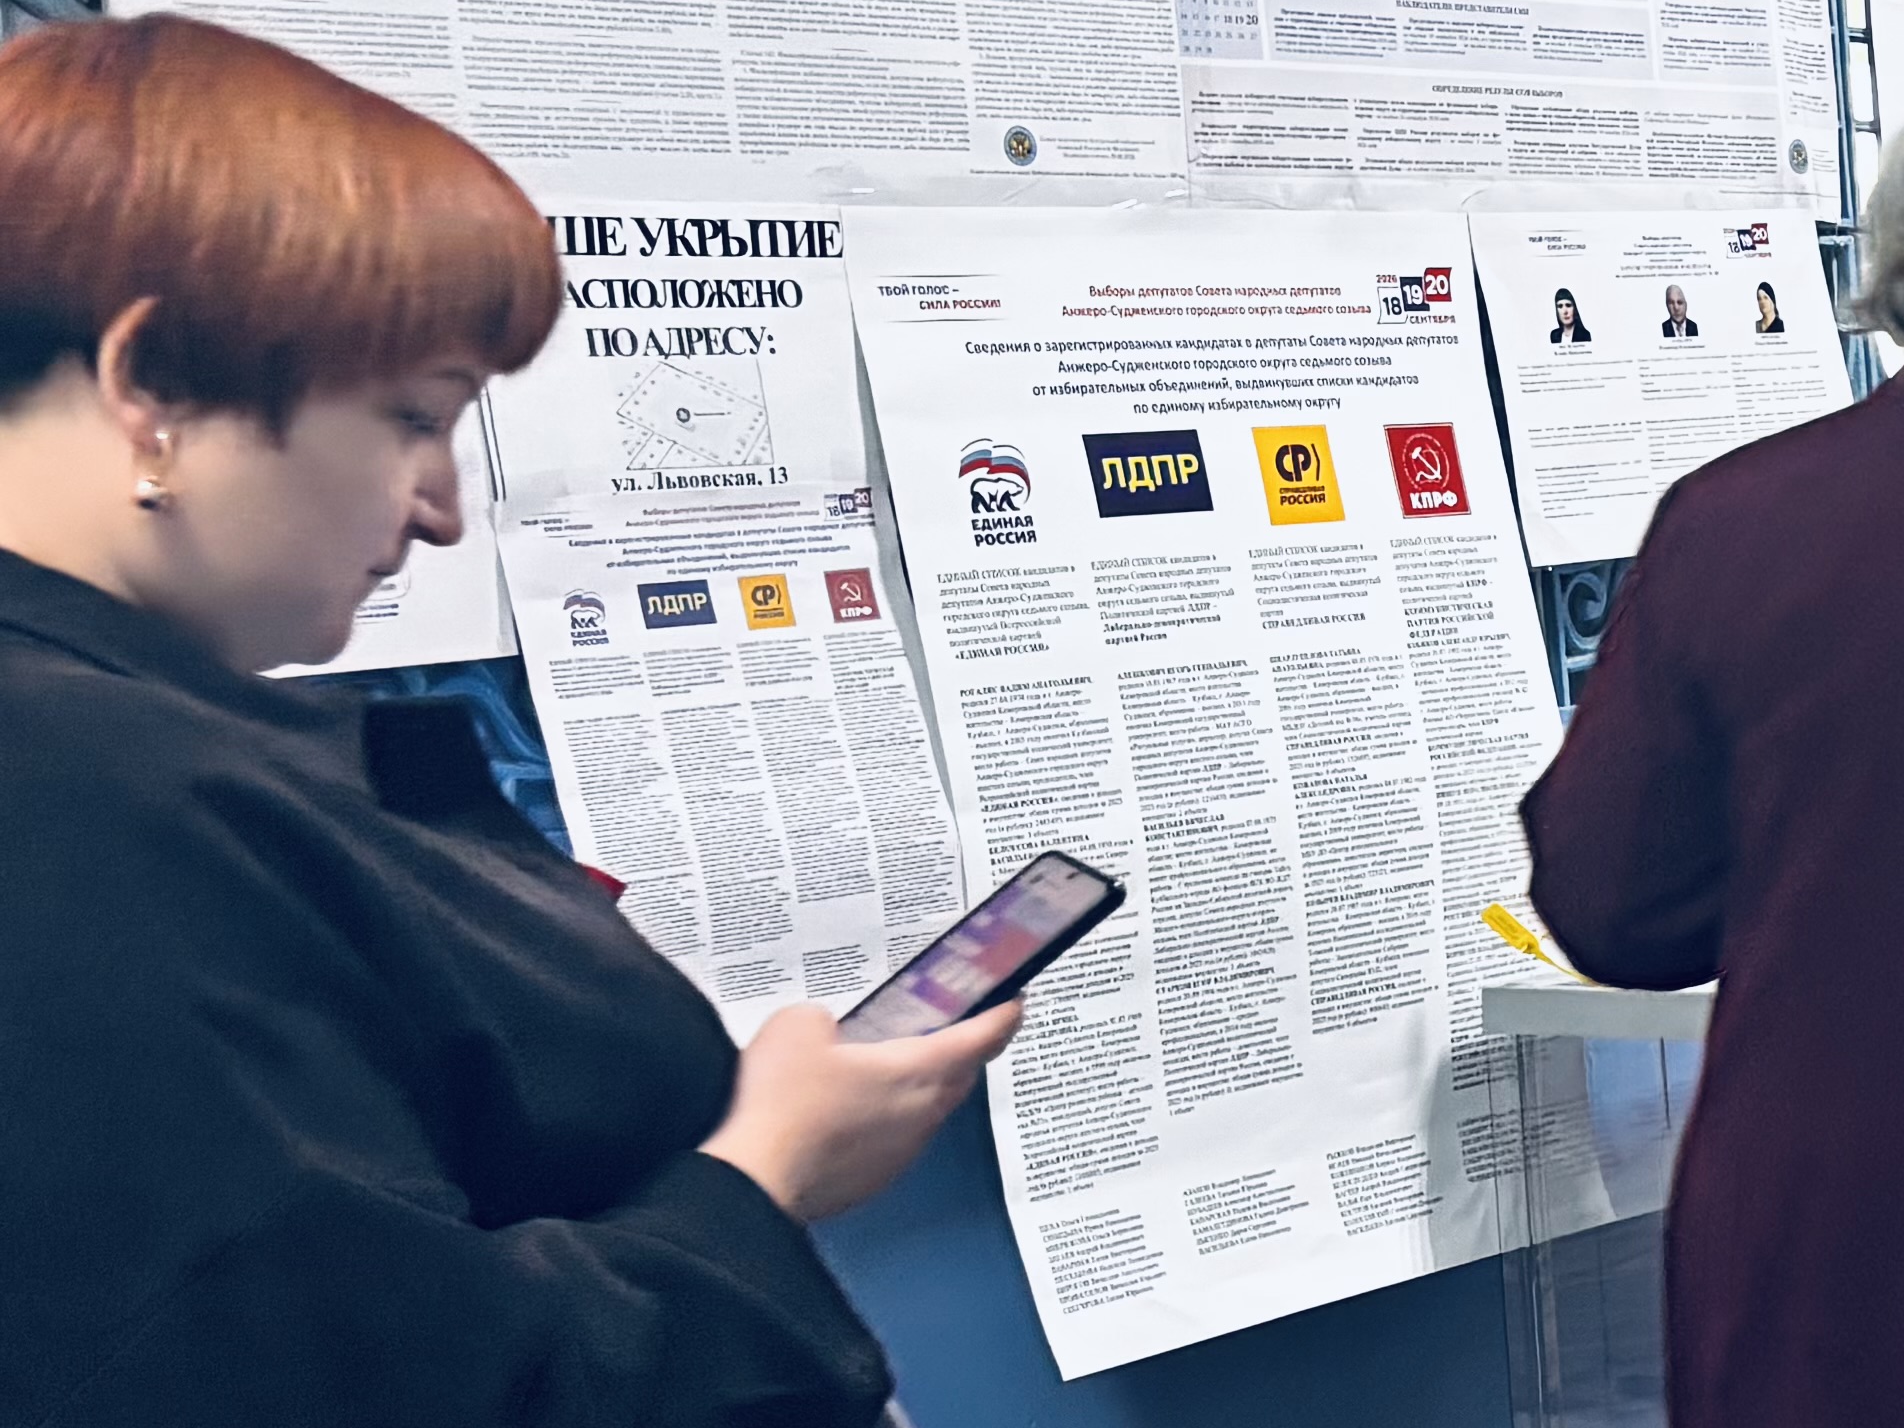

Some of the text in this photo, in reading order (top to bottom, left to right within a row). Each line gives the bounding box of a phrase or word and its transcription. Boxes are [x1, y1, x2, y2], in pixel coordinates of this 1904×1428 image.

[1245, 14, 1258, 25] 20
[545, 216, 843, 258] ШЕ УКРЫТИЕ
[1752, 227, 1768, 241] 20
[565, 278, 802, 309] АСПОЛОЖЕНО
[877, 284, 949, 296] ТВОЙ ГОЛОС
[1088, 284, 1135, 299] Выборы
[1137, 287, 1193, 298] депутатов
[1195, 285, 1232, 296] Совета
[1234, 287, 1287, 297] народных
[1382, 275, 1449, 315] 18 19 20
[919, 300, 950, 310] СИЛА
[1062, 304, 1183, 318] Анжеро-Судженского
[1185, 306, 1246, 317] городского
[1247, 305, 1283, 316] округа
[1284, 305, 1334, 315] седьмого
[586, 326, 776, 359] ПО АДРЕСУ:
[964, 341, 1031, 355] Сведения
[1044, 340, 1173, 354] зарегистрированных
[1175, 338, 1243, 351] кандидатах
[1255, 337, 1307, 350] депутаты
[1309, 335, 1346, 347] Совета
[1348, 336, 1403, 348] народных
[1405, 335, 1458, 347] депутатов
[1058, 356, 1392, 374] Анжеро-Судженского городского округа седьмого созыва
[1032, 385, 1046, 396] от
[1049, 382, 1146, 397] избирательных
[1148, 377, 1232, 393] объединений,
[1316, 377, 1354, 387] списки
[1355, 375, 1419, 387] кандидатов
[1133, 397, 1341, 414] по единому избирательному округу
[612, 476, 642, 495] ул.
[769, 467, 788, 485] 13
[1101, 453, 1199, 493] ЛДПР
[826, 505, 840, 518] 18
[855, 491, 870, 504] 20
[1280, 493, 1326, 506] РОССИЯ
[1409, 490, 1458, 509] КПРФ
[971, 515, 1034, 532] ЕДИНАЯ
[974, 530, 1037, 547] РОССИЯ
[648, 592, 707, 616] ЛДПР
